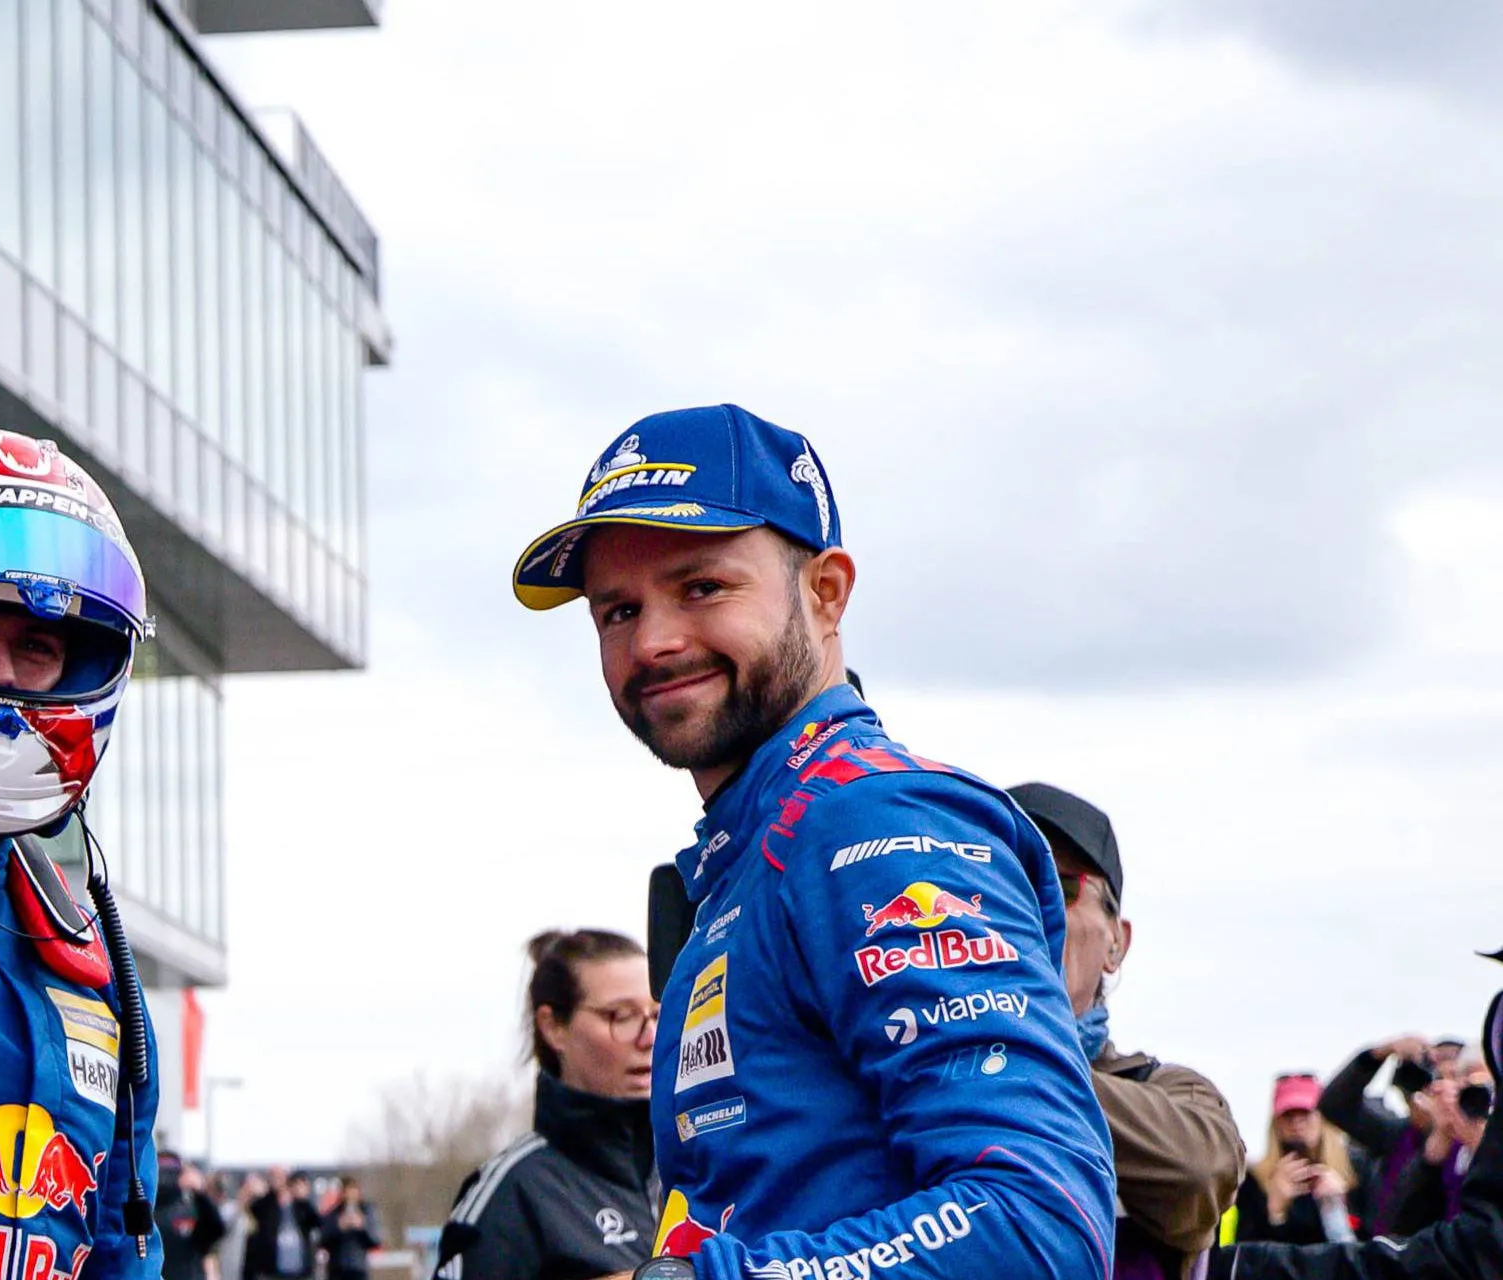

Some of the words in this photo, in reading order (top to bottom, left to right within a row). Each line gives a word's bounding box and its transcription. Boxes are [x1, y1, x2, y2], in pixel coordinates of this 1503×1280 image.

[881, 836, 992, 864] AMG
[855, 932, 937, 987] Red
[921, 989, 1028, 1025] viaplay
[695, 1104, 744, 1126] MICHELIN
[912, 1201, 972, 1250] 0.0
